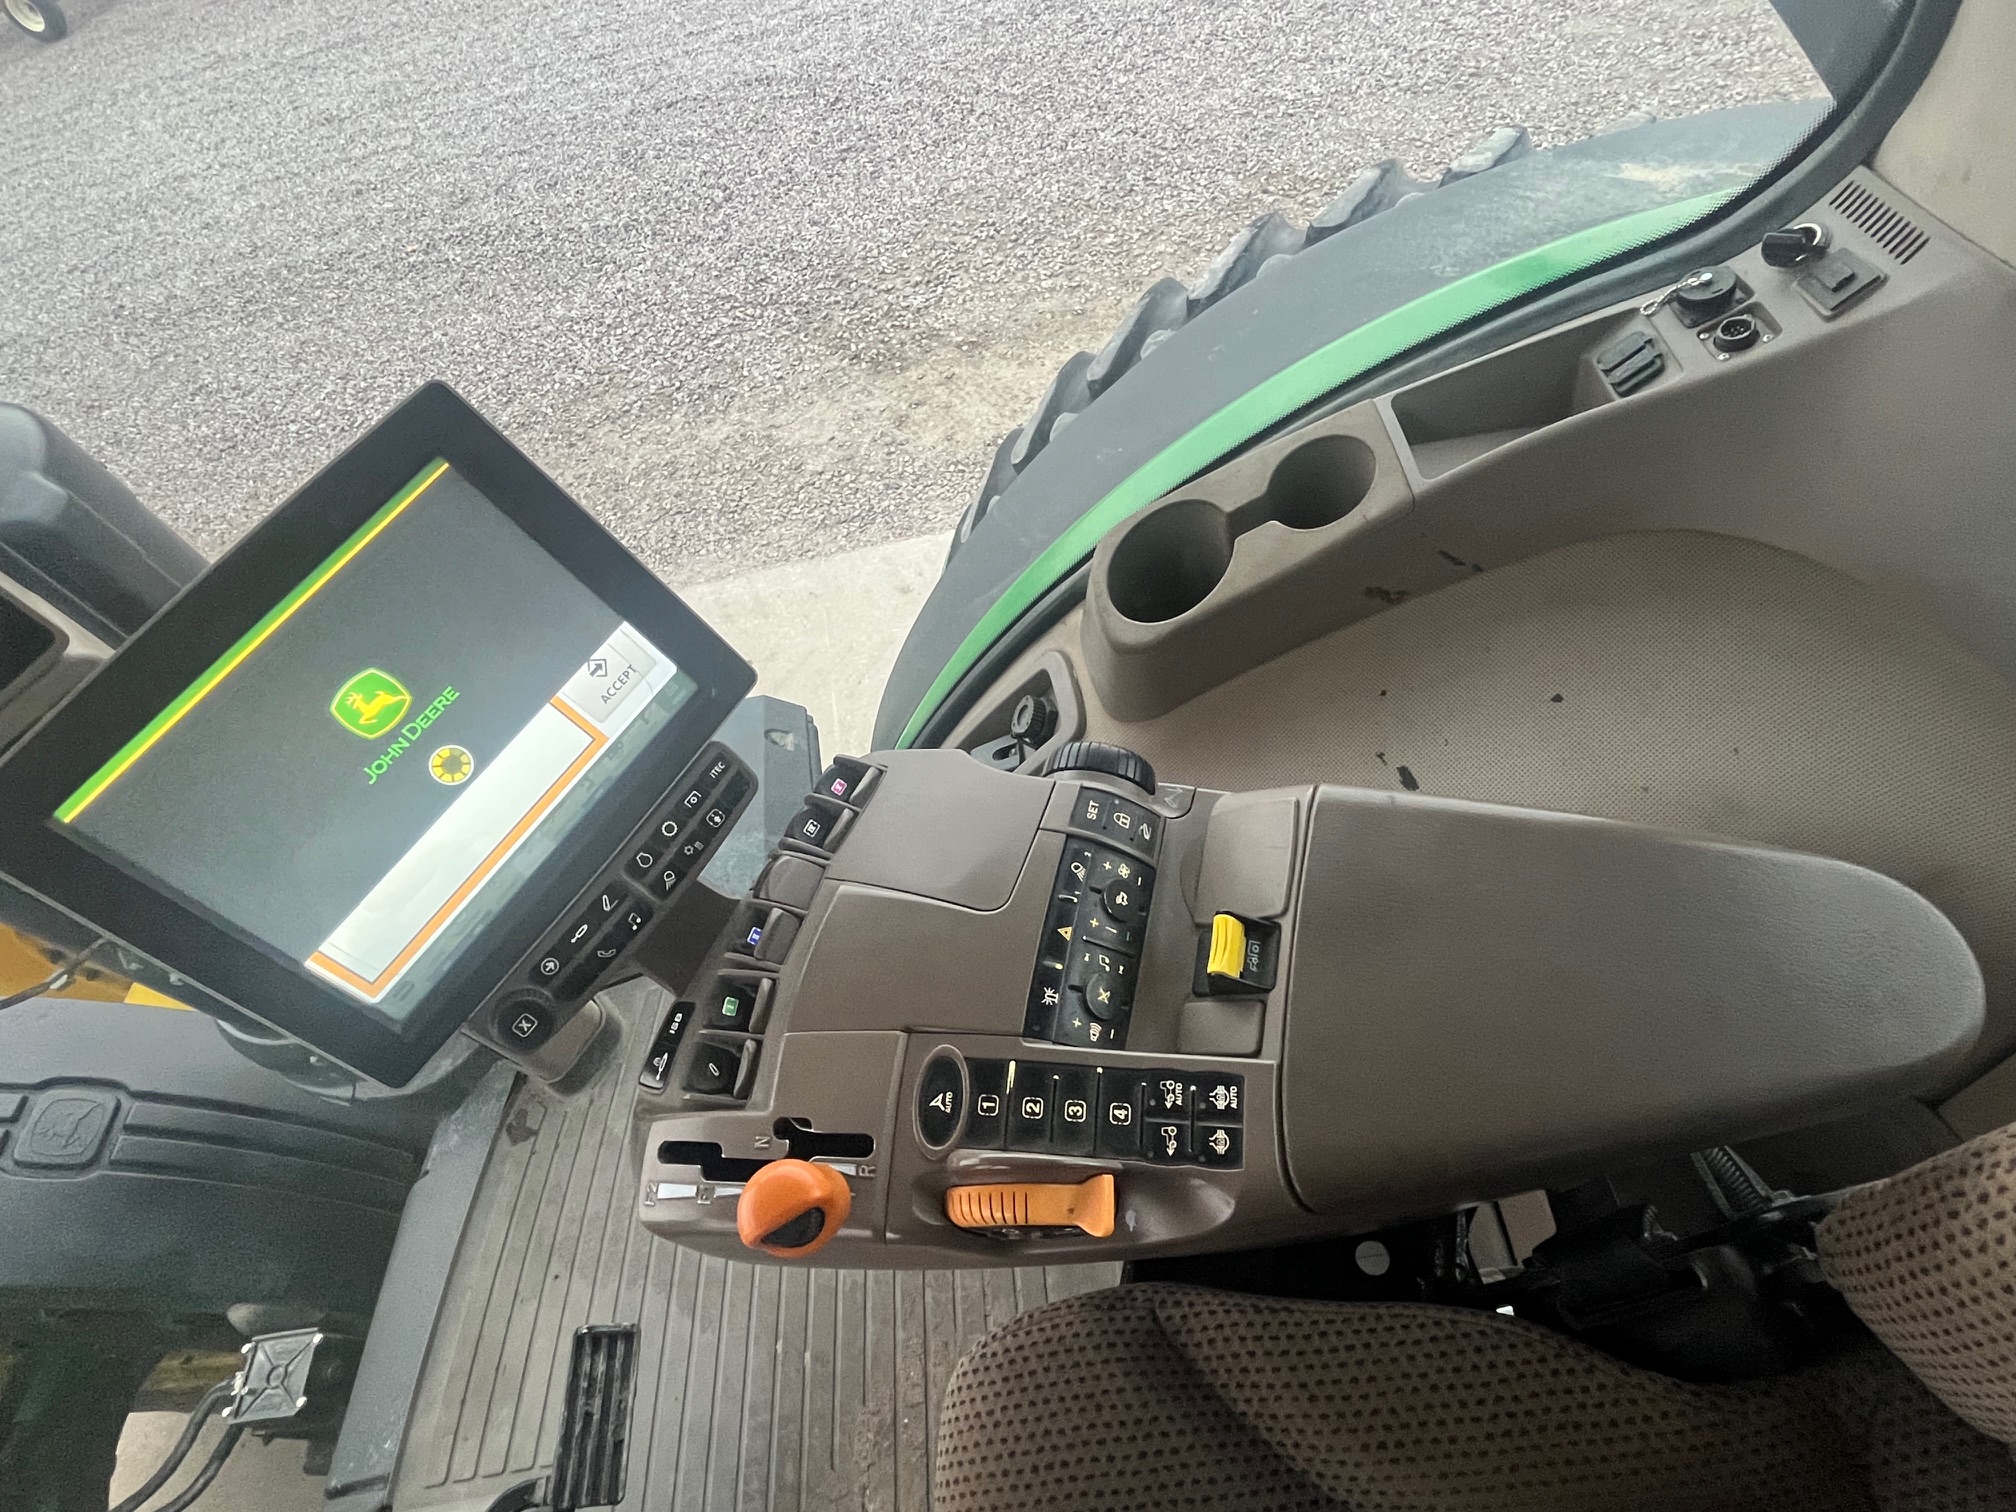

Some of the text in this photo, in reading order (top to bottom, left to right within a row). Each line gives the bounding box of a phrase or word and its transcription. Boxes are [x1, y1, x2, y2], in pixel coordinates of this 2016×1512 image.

[600, 664, 637, 705] ACCEPT
[363, 685, 460, 785] JOHN DEERE
[1086, 799, 1100, 821] SET
[945, 1091, 953, 1114] AUTO
[1175, 1082, 1183, 1106] AUTO
[1229, 1085, 1238, 1110] AUTO
[981, 1101, 996, 1110] 1
[1025, 1102, 1041, 1114] 2
[1068, 1105, 1083, 1117] 3
[1113, 1108, 1128, 1120] 4
[754, 1135, 771, 1149] N
[859, 1164, 876, 1178] R
